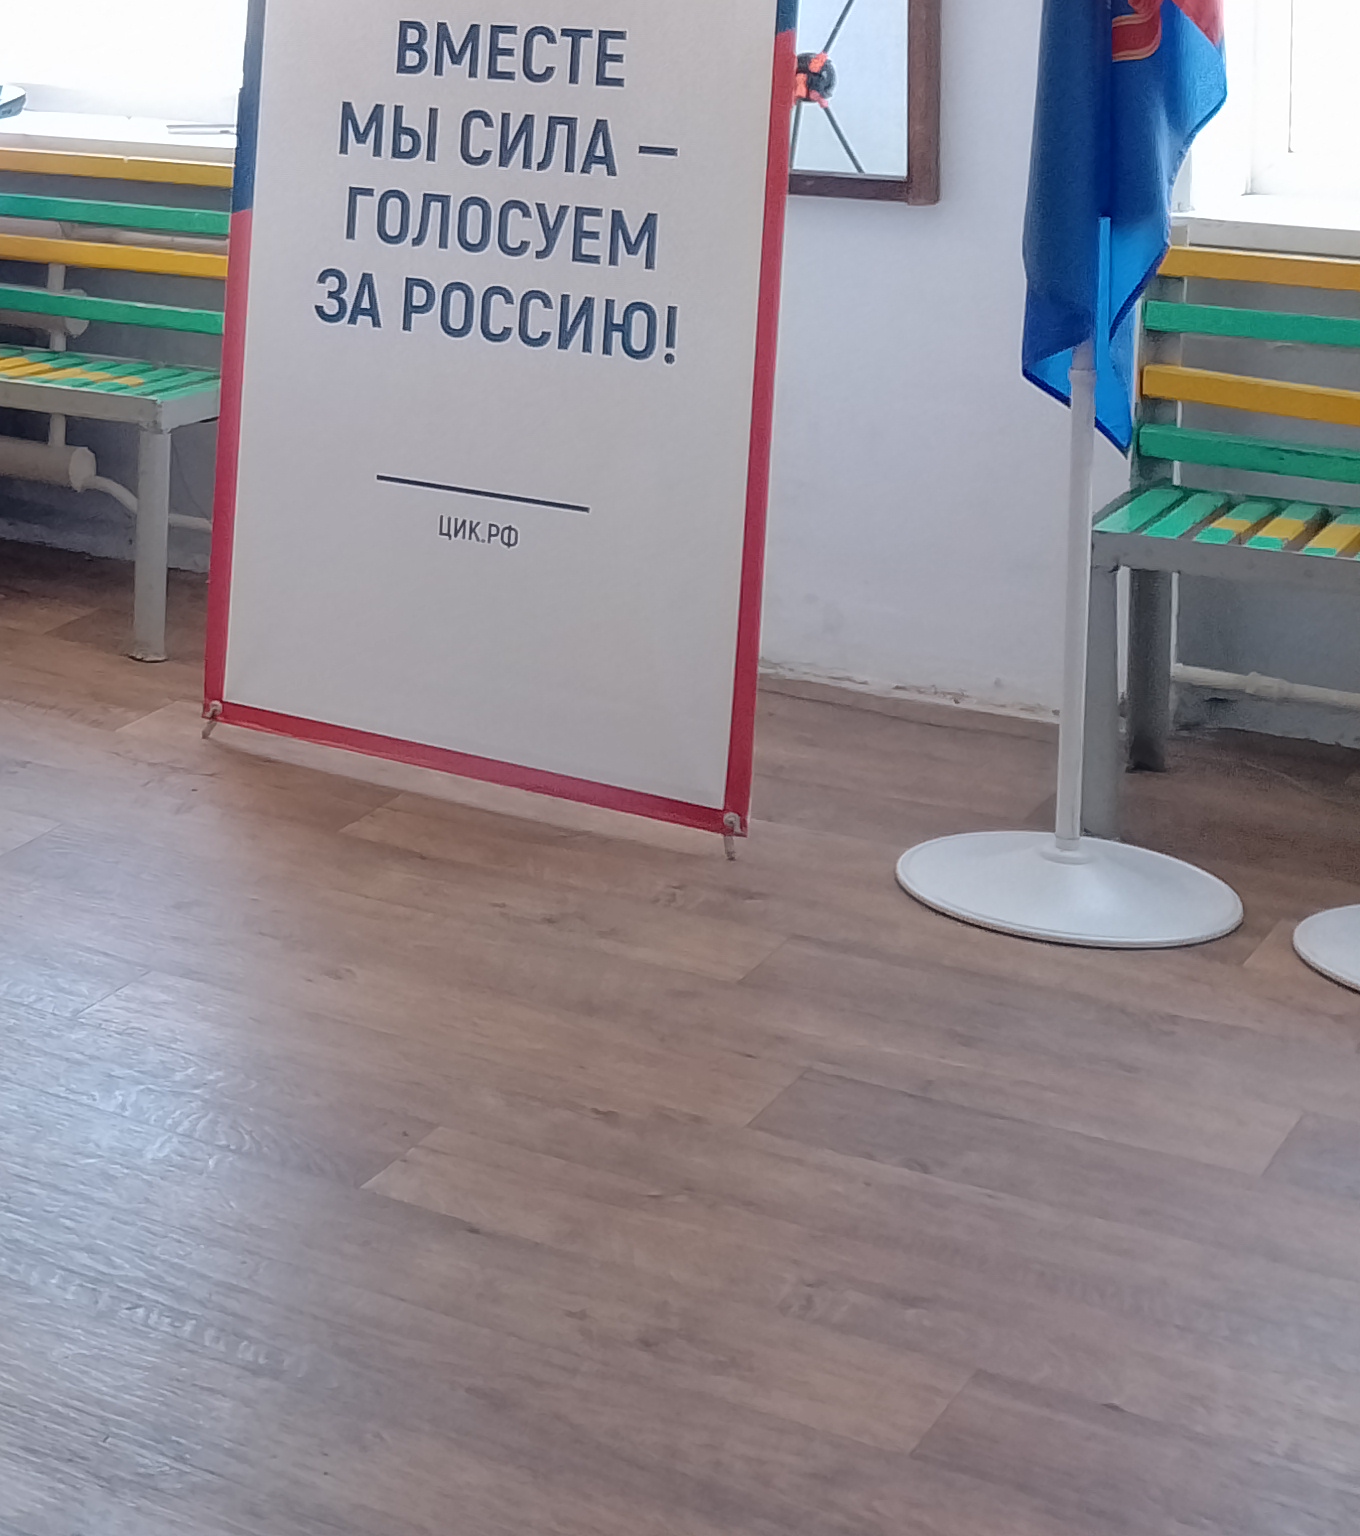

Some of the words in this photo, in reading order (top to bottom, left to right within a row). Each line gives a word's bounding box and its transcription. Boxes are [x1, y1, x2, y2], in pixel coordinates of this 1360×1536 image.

[395, 19, 628, 88] ВМЕСТЕ
[338, 100, 440, 163] МЫ
[458, 108, 618, 177] СИЛА
[344, 185, 659, 271] ГОЛОСУЕМ
[313, 267, 382, 329] ЗА
[401, 276, 678, 365] РОССИЮ!
[437, 514, 520, 549] ЦИК.РФ
